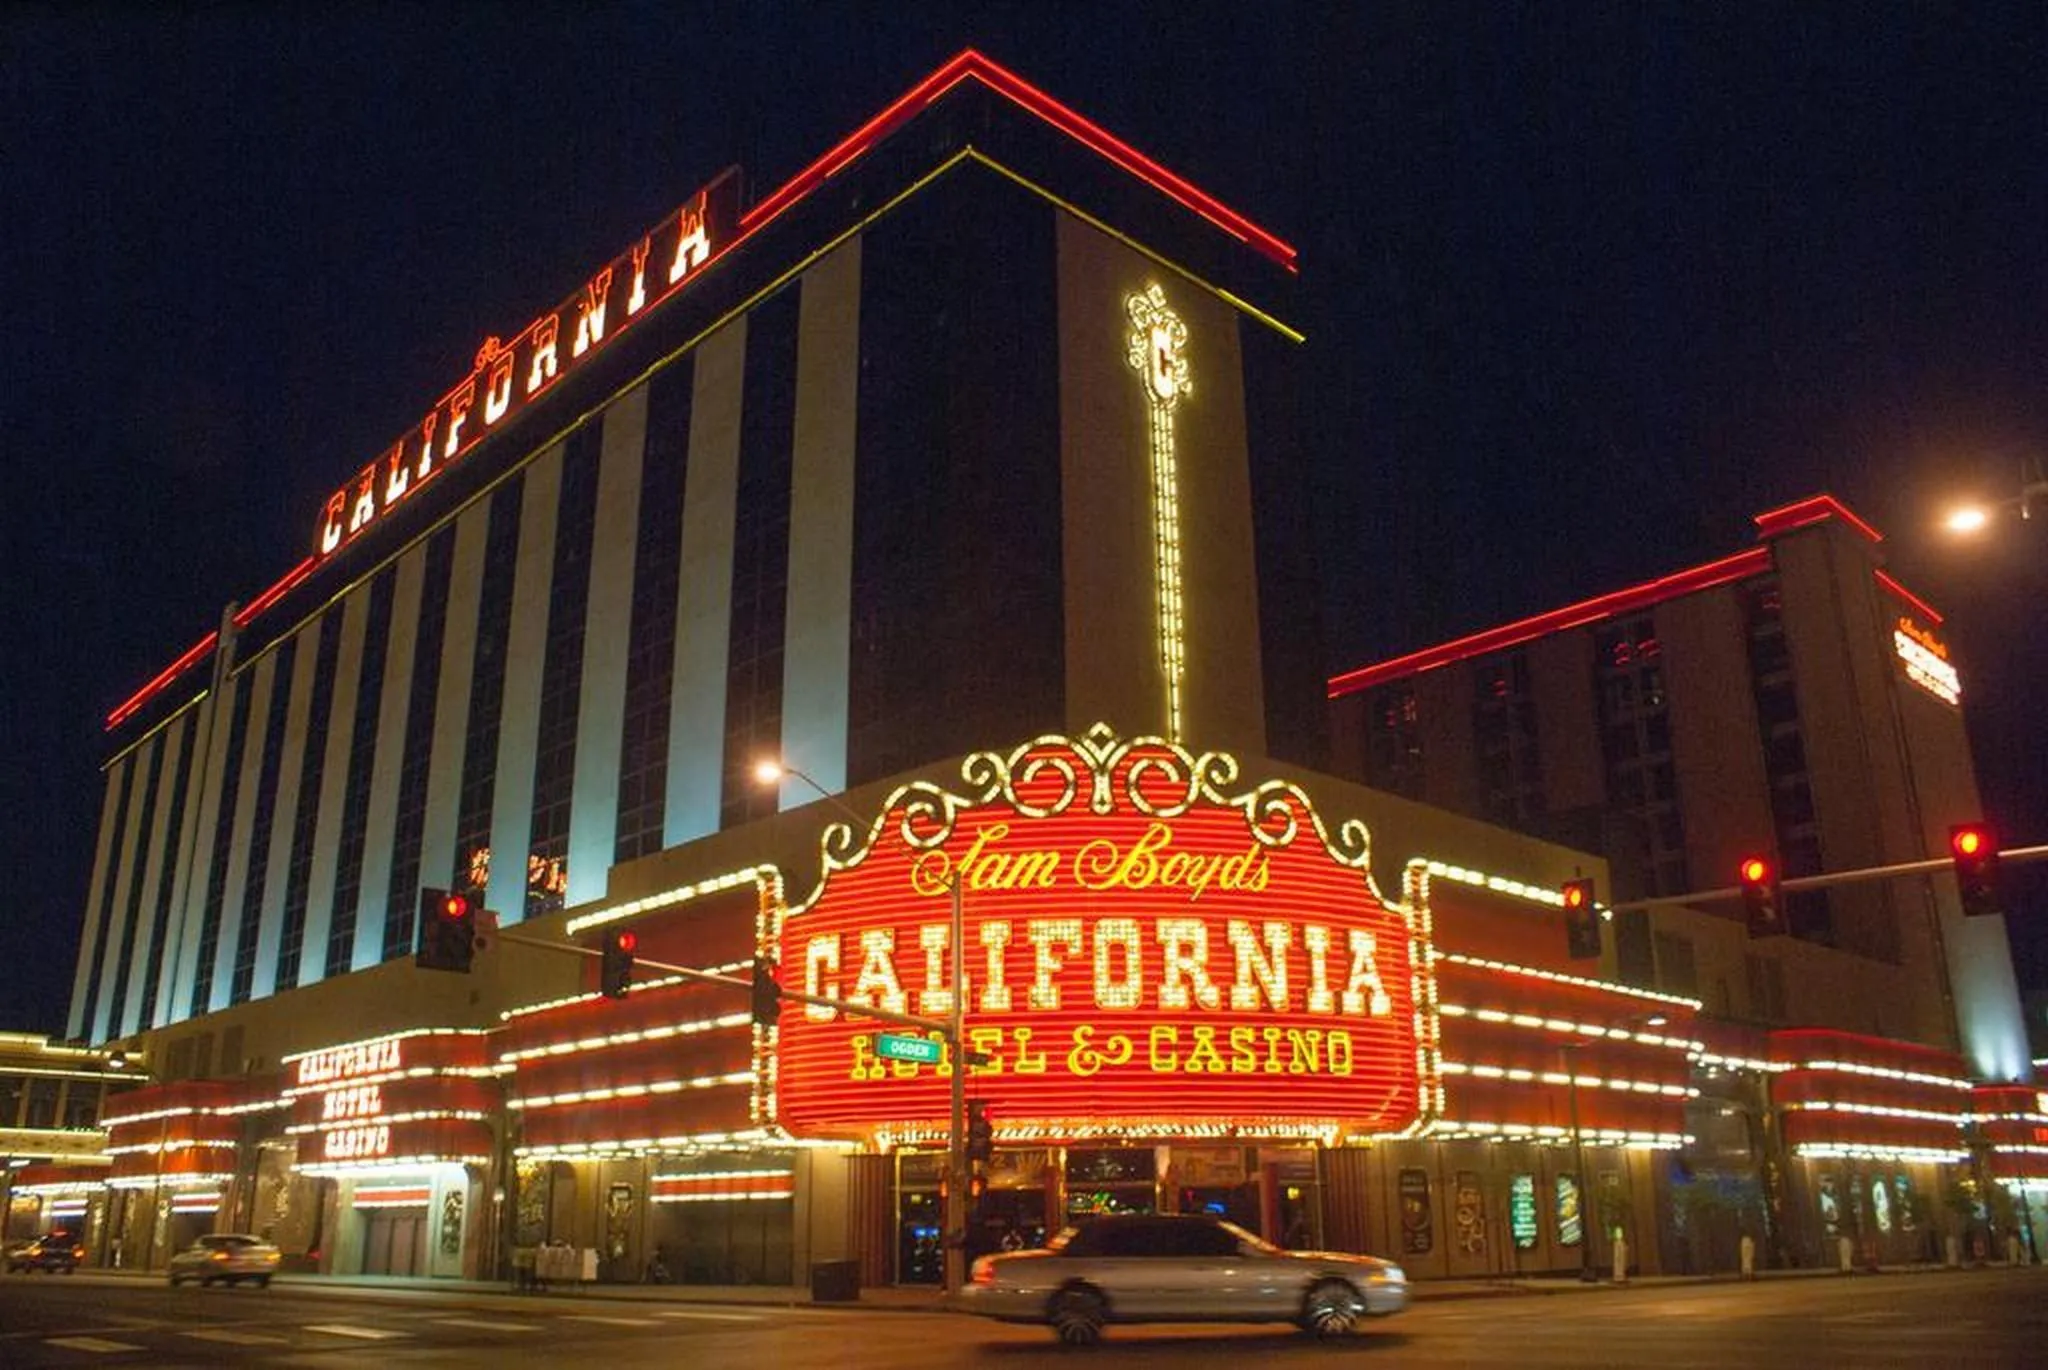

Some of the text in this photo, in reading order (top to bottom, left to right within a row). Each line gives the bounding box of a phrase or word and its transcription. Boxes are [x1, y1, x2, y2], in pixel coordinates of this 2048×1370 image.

[320, 190, 711, 553] CALIFORNIA
[911, 824, 1059, 896] Sam
[803, 918, 1392, 1021] CALIFORNIA
[891, 1040, 929, 1056] OGDEN
[1068, 1026, 1131, 1077] &
[1150, 1027, 1353, 1076] CASINO
[323, 1086, 381, 1119] HOTEL
[326, 1127, 389, 1157] CASINO
